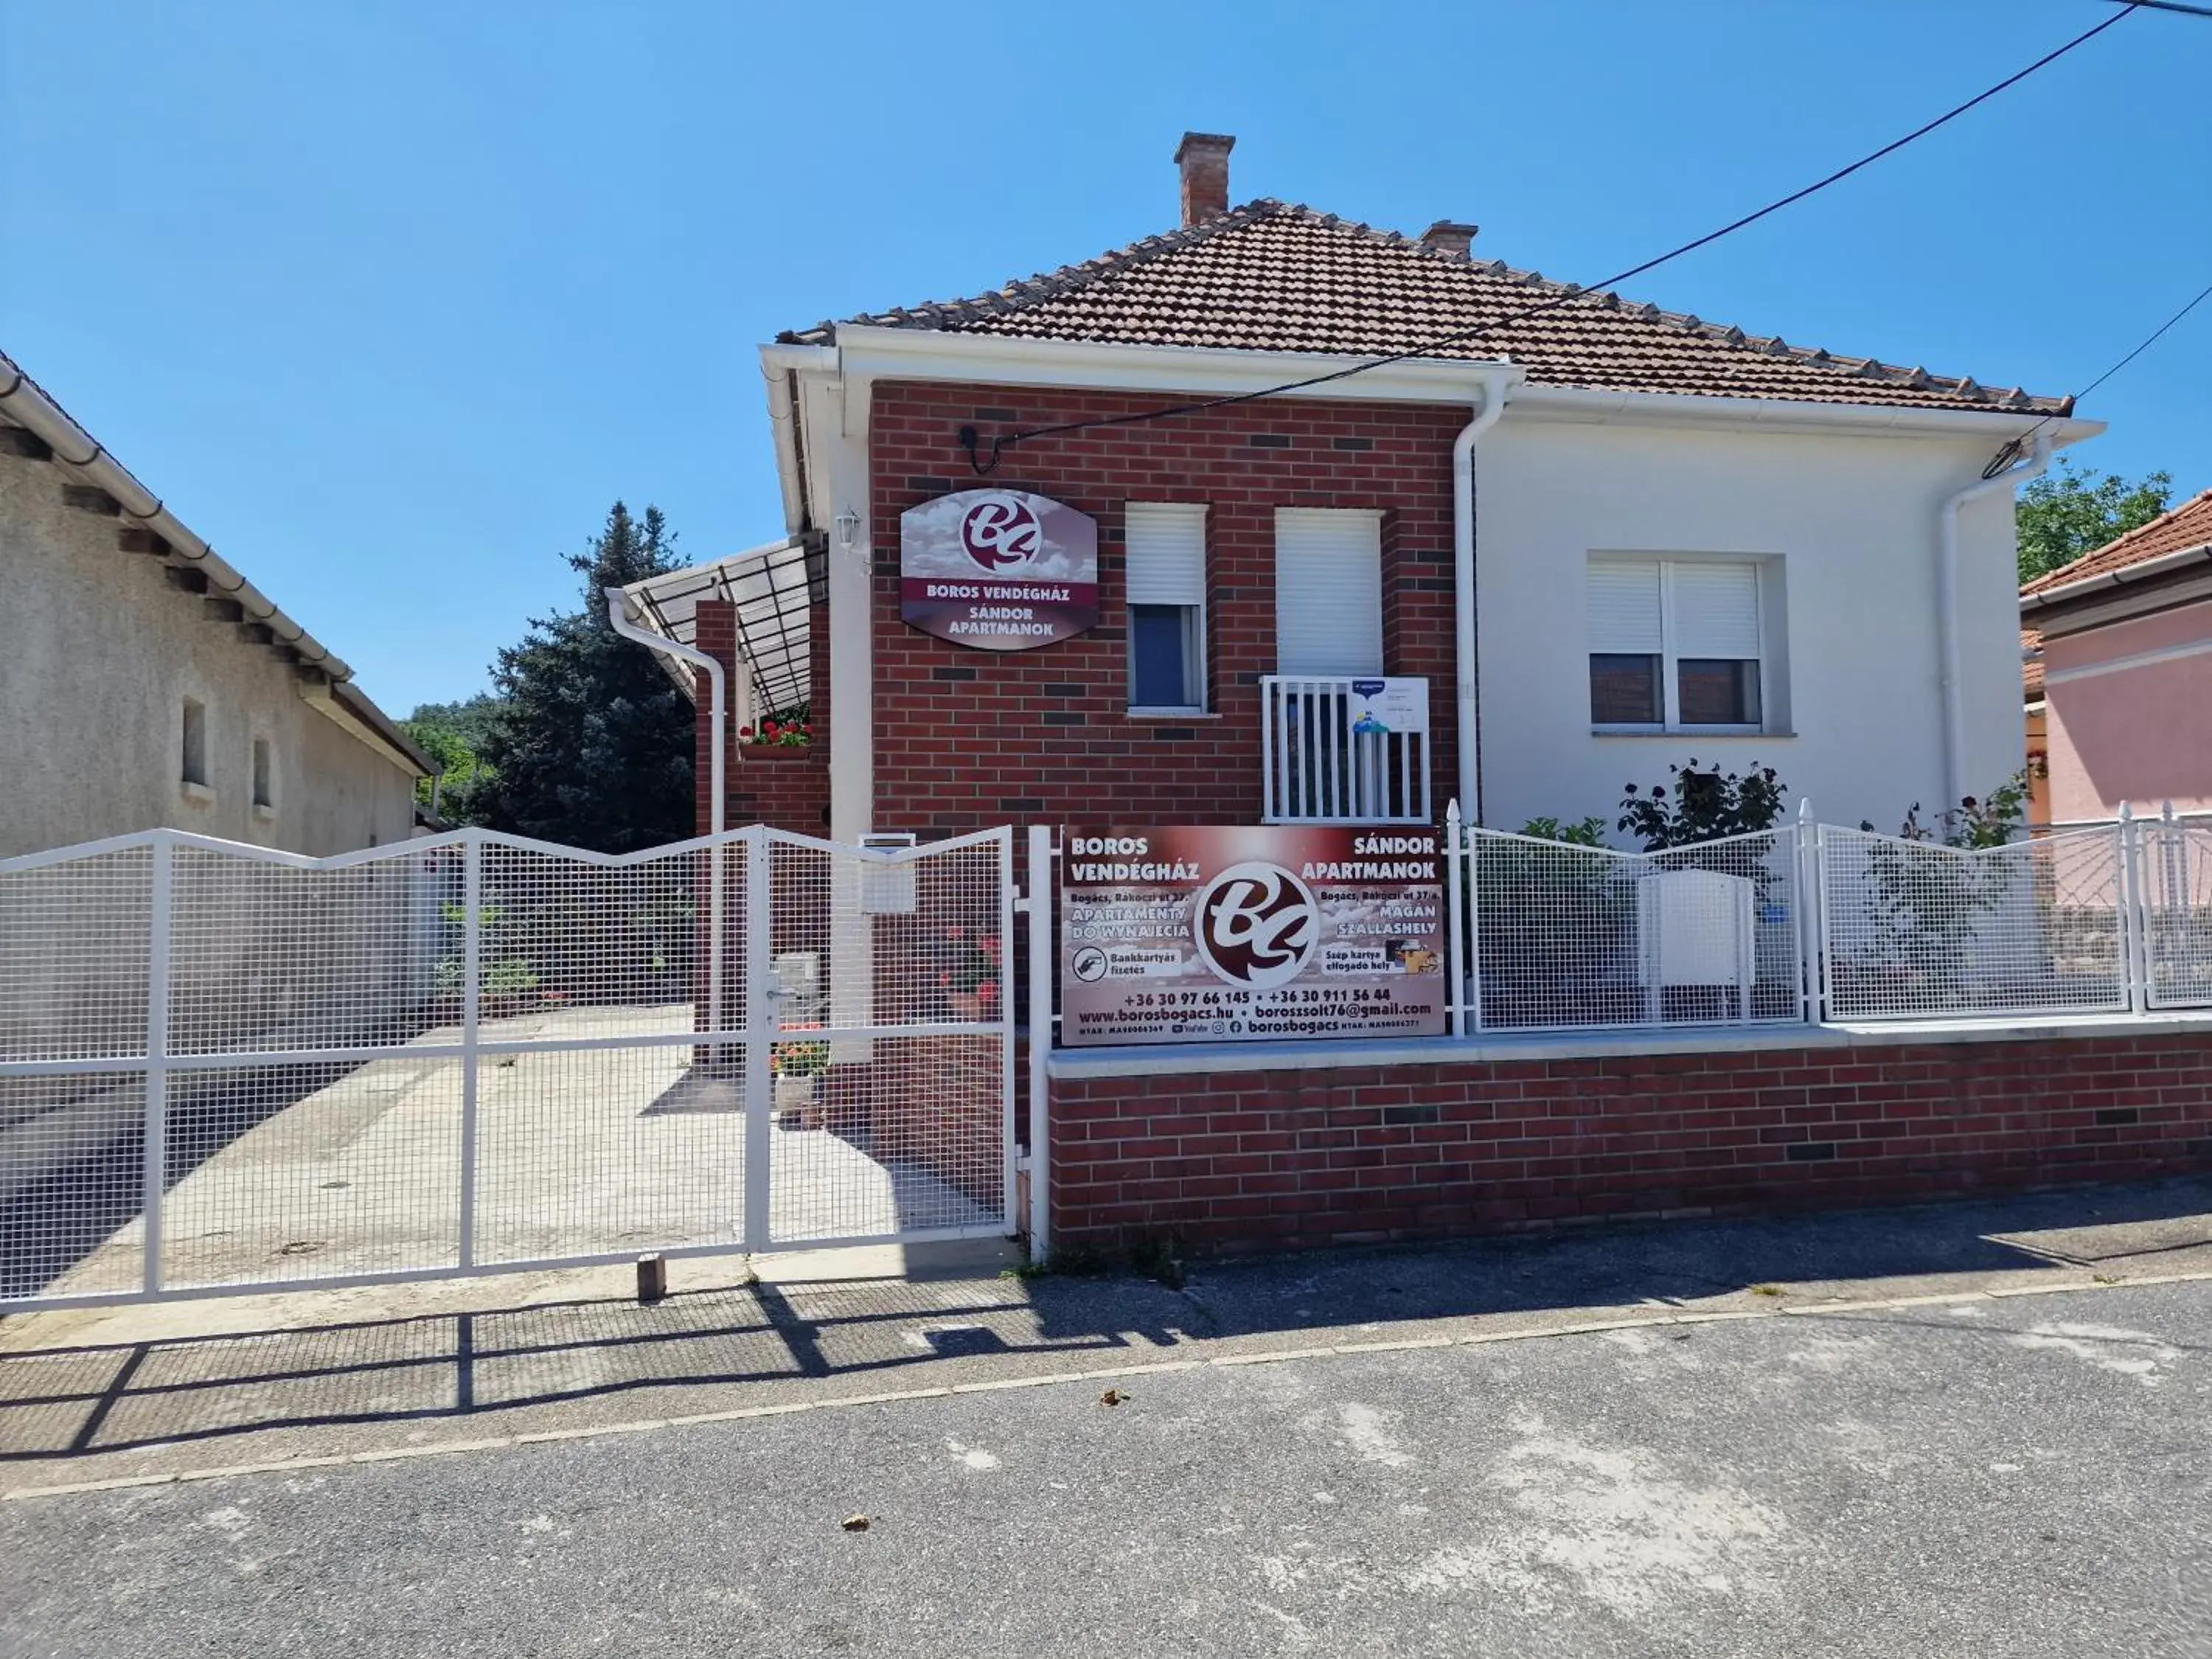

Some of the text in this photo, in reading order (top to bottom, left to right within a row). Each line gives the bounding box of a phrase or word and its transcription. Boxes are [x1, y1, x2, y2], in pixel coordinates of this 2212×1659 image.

[927, 582, 1070, 601] BOROS VENDÉGHÁZ
[970, 603, 1033, 620] SÁNDOR
[949, 621, 1053, 636] APARTMANOK
[1071, 837, 1148, 855] BOROS
[1354, 832, 1435, 855] SÁNDOR
[1071, 858, 1200, 881] VENDÉGHÁZ
[1301, 862, 1436, 880] APARTMANOK
[1071, 908, 1187, 921] APARTAMENTY
[1124, 989, 1391, 1006] +36 30 97 66 145 +36 30 911 56 44
[1079, 1003, 1431, 1023] www.borosbogacs.hu boroszsolt76@gmail.com
[1248, 1020, 1339, 1034] borosbogacs
